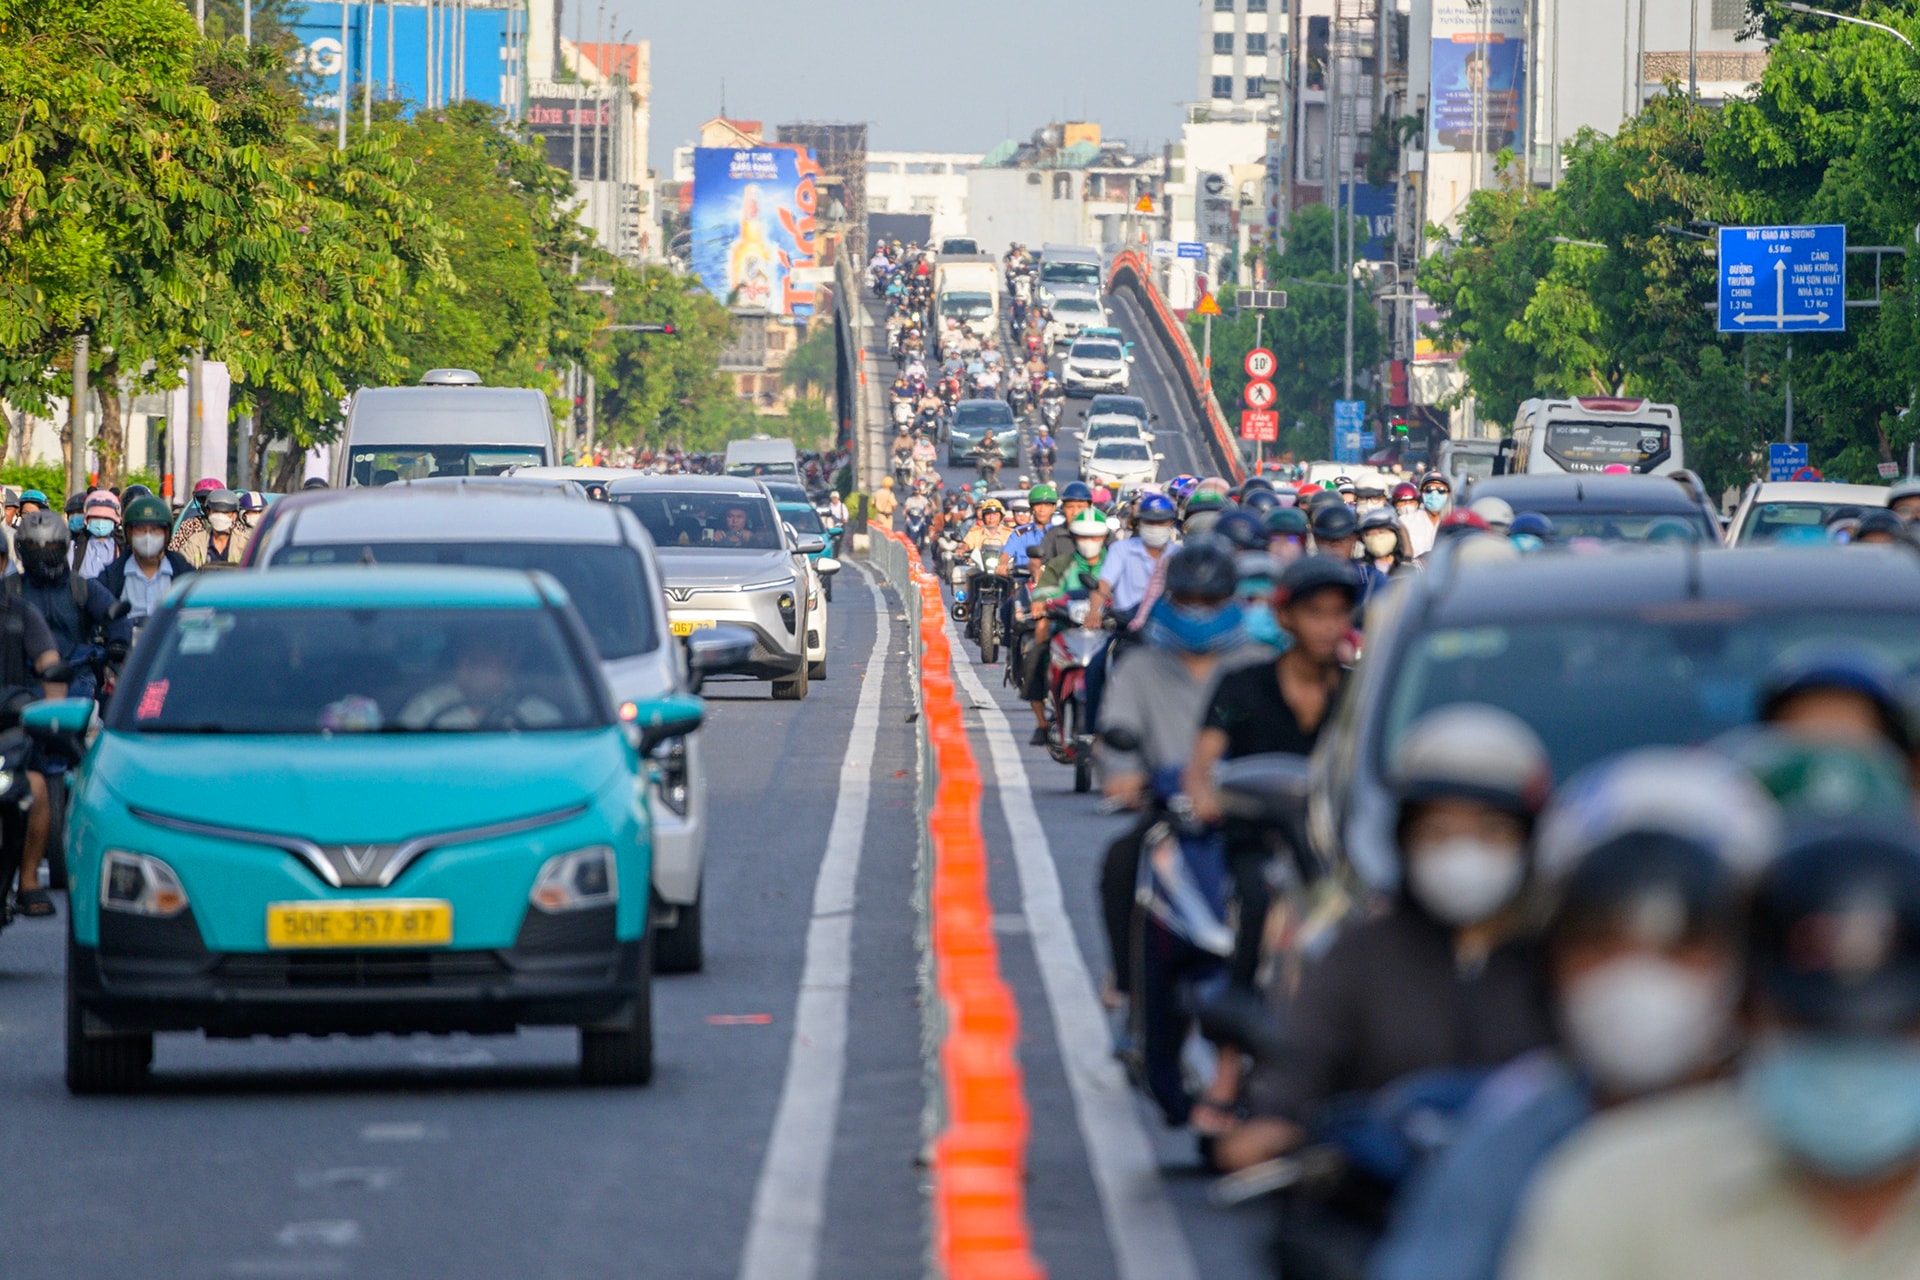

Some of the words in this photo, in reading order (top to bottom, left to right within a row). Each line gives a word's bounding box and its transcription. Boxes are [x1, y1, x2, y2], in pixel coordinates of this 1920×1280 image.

[1780, 230, 1789, 240] AN
[1780, 245, 1792, 253] Km
[1814, 287, 1824, 296] GA
[1741, 301, 1753, 309] Km
